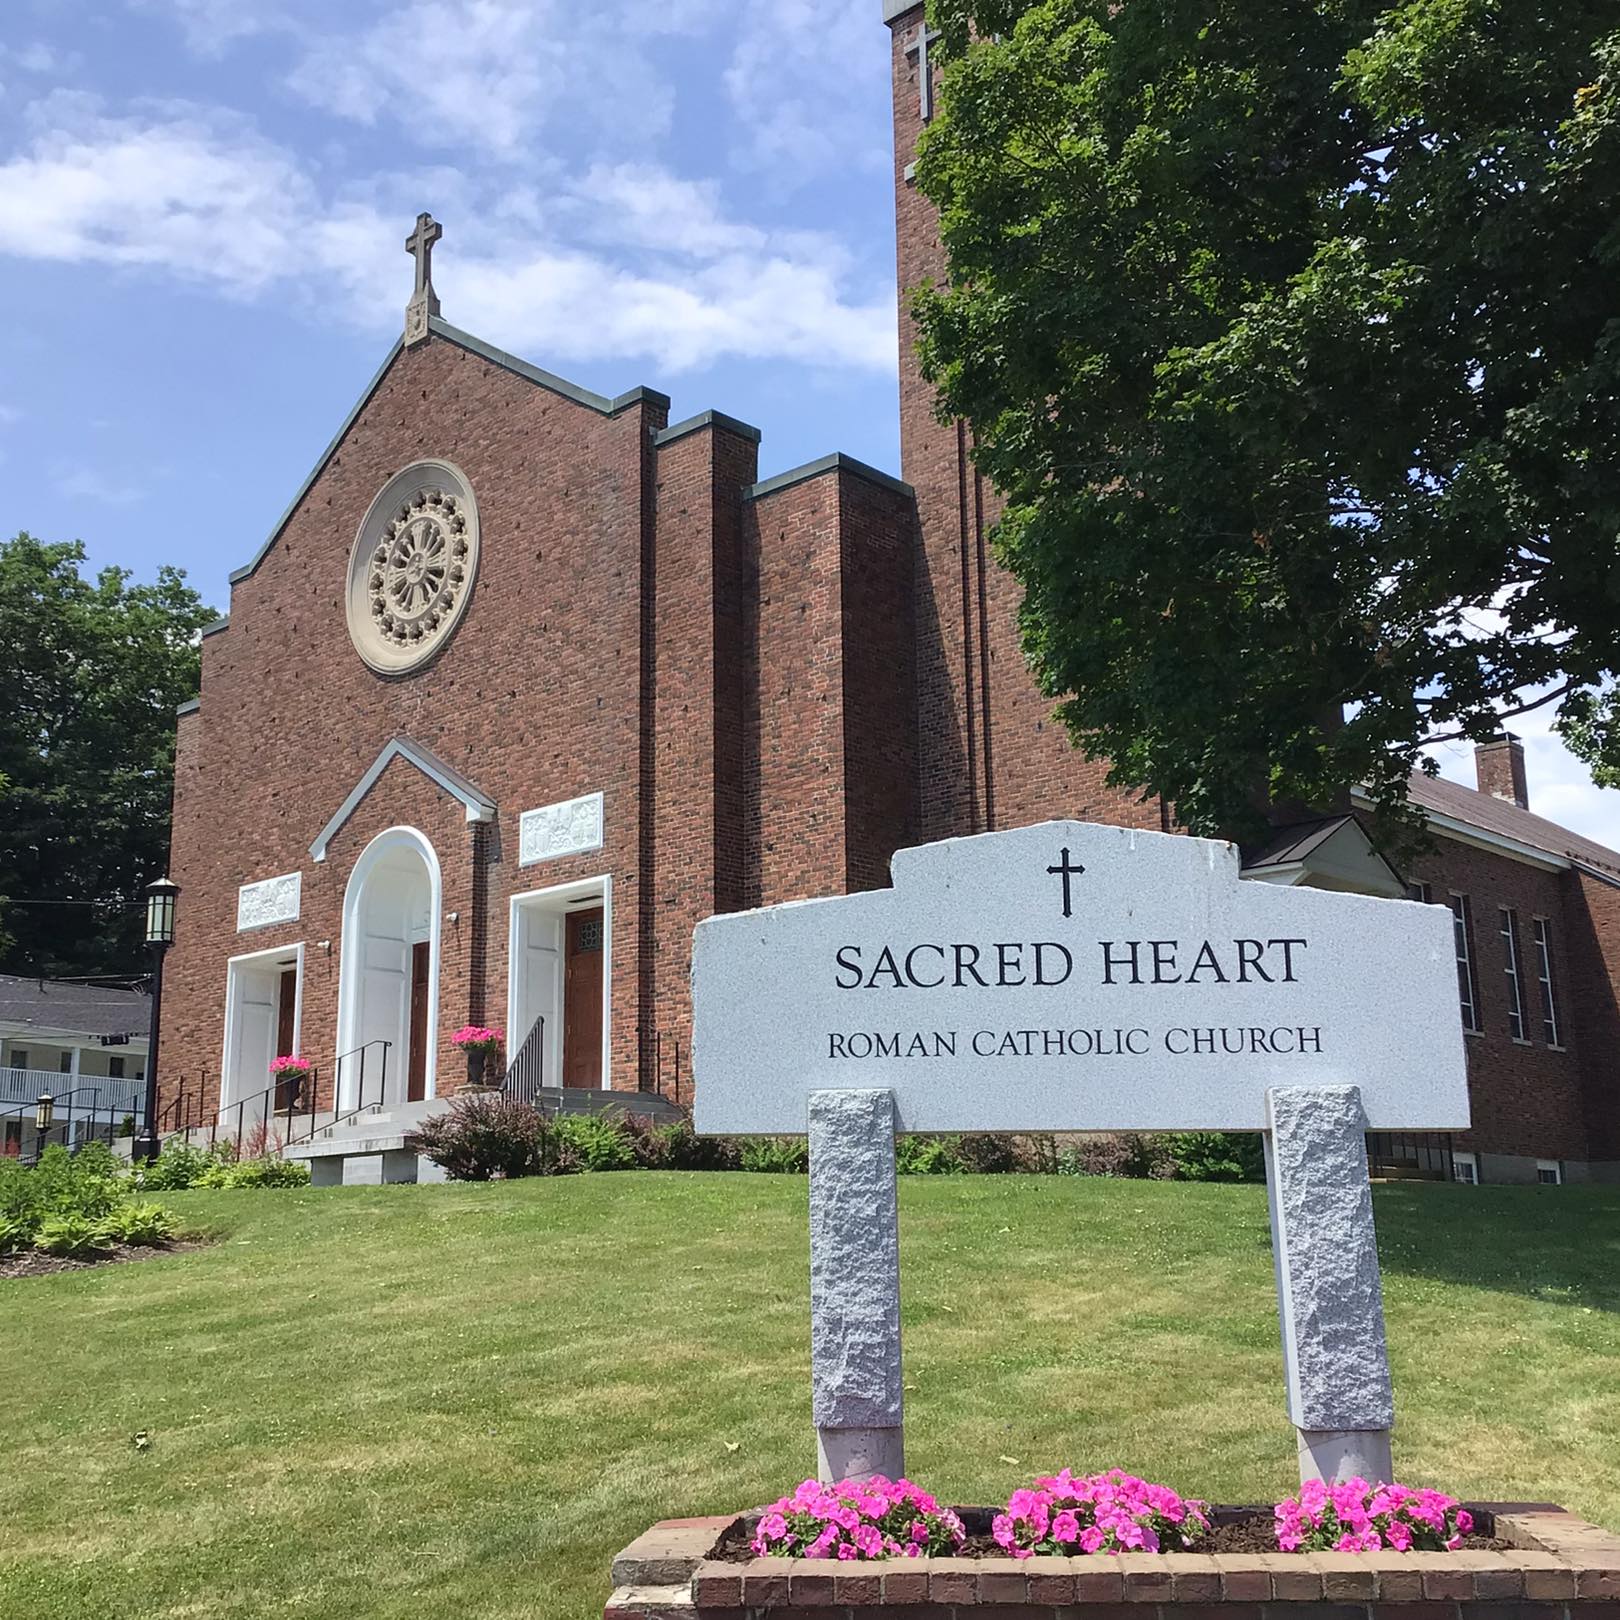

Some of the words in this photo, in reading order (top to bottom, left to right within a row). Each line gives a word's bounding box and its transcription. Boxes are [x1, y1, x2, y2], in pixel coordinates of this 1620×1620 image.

[836, 942, 1073, 990] SACRED
[1098, 938, 1308, 986] HEART
[827, 1031, 957, 1059] ROMAN
[971, 1029, 1150, 1057] CATHOLIC
[1164, 1027, 1324, 1055] CHURCH
